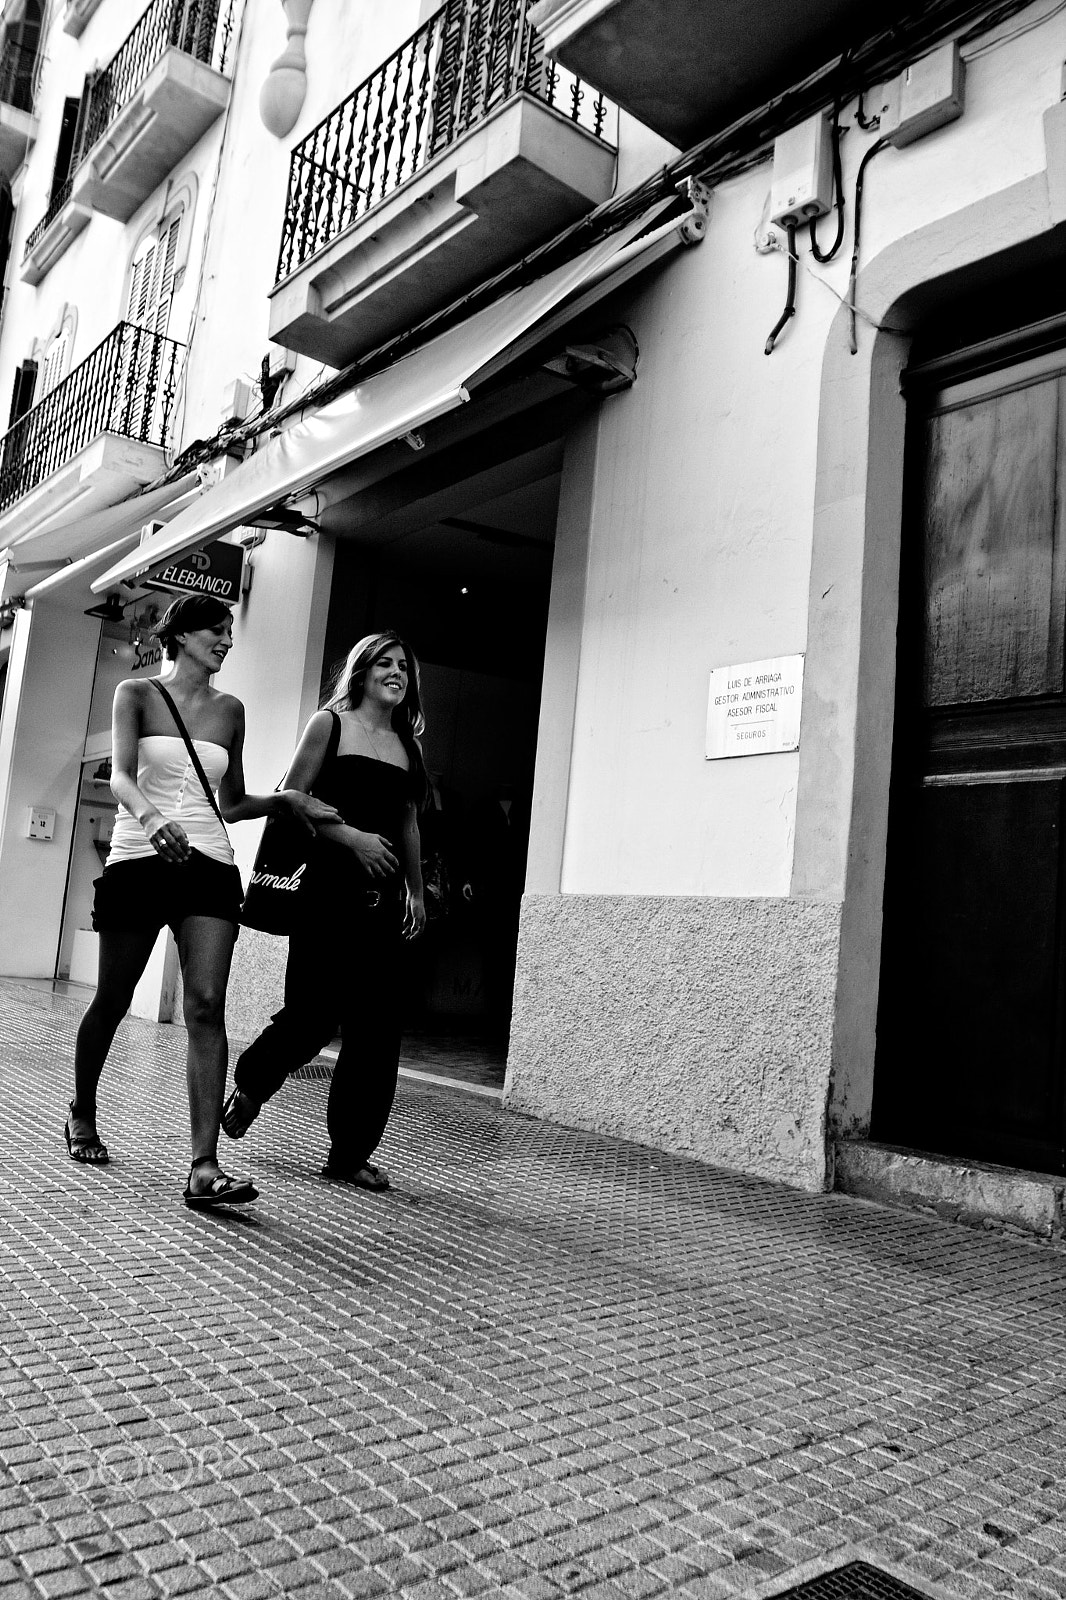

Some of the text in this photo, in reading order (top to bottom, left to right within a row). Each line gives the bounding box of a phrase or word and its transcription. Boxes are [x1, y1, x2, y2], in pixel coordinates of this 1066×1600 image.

[727, 673, 782, 690] LUIS DE ARRIAGA
[714, 694, 739, 706] GESTOR
[727, 703, 778, 718] ASESOR FISCAL
[736, 730, 767, 741] SEGUROS
